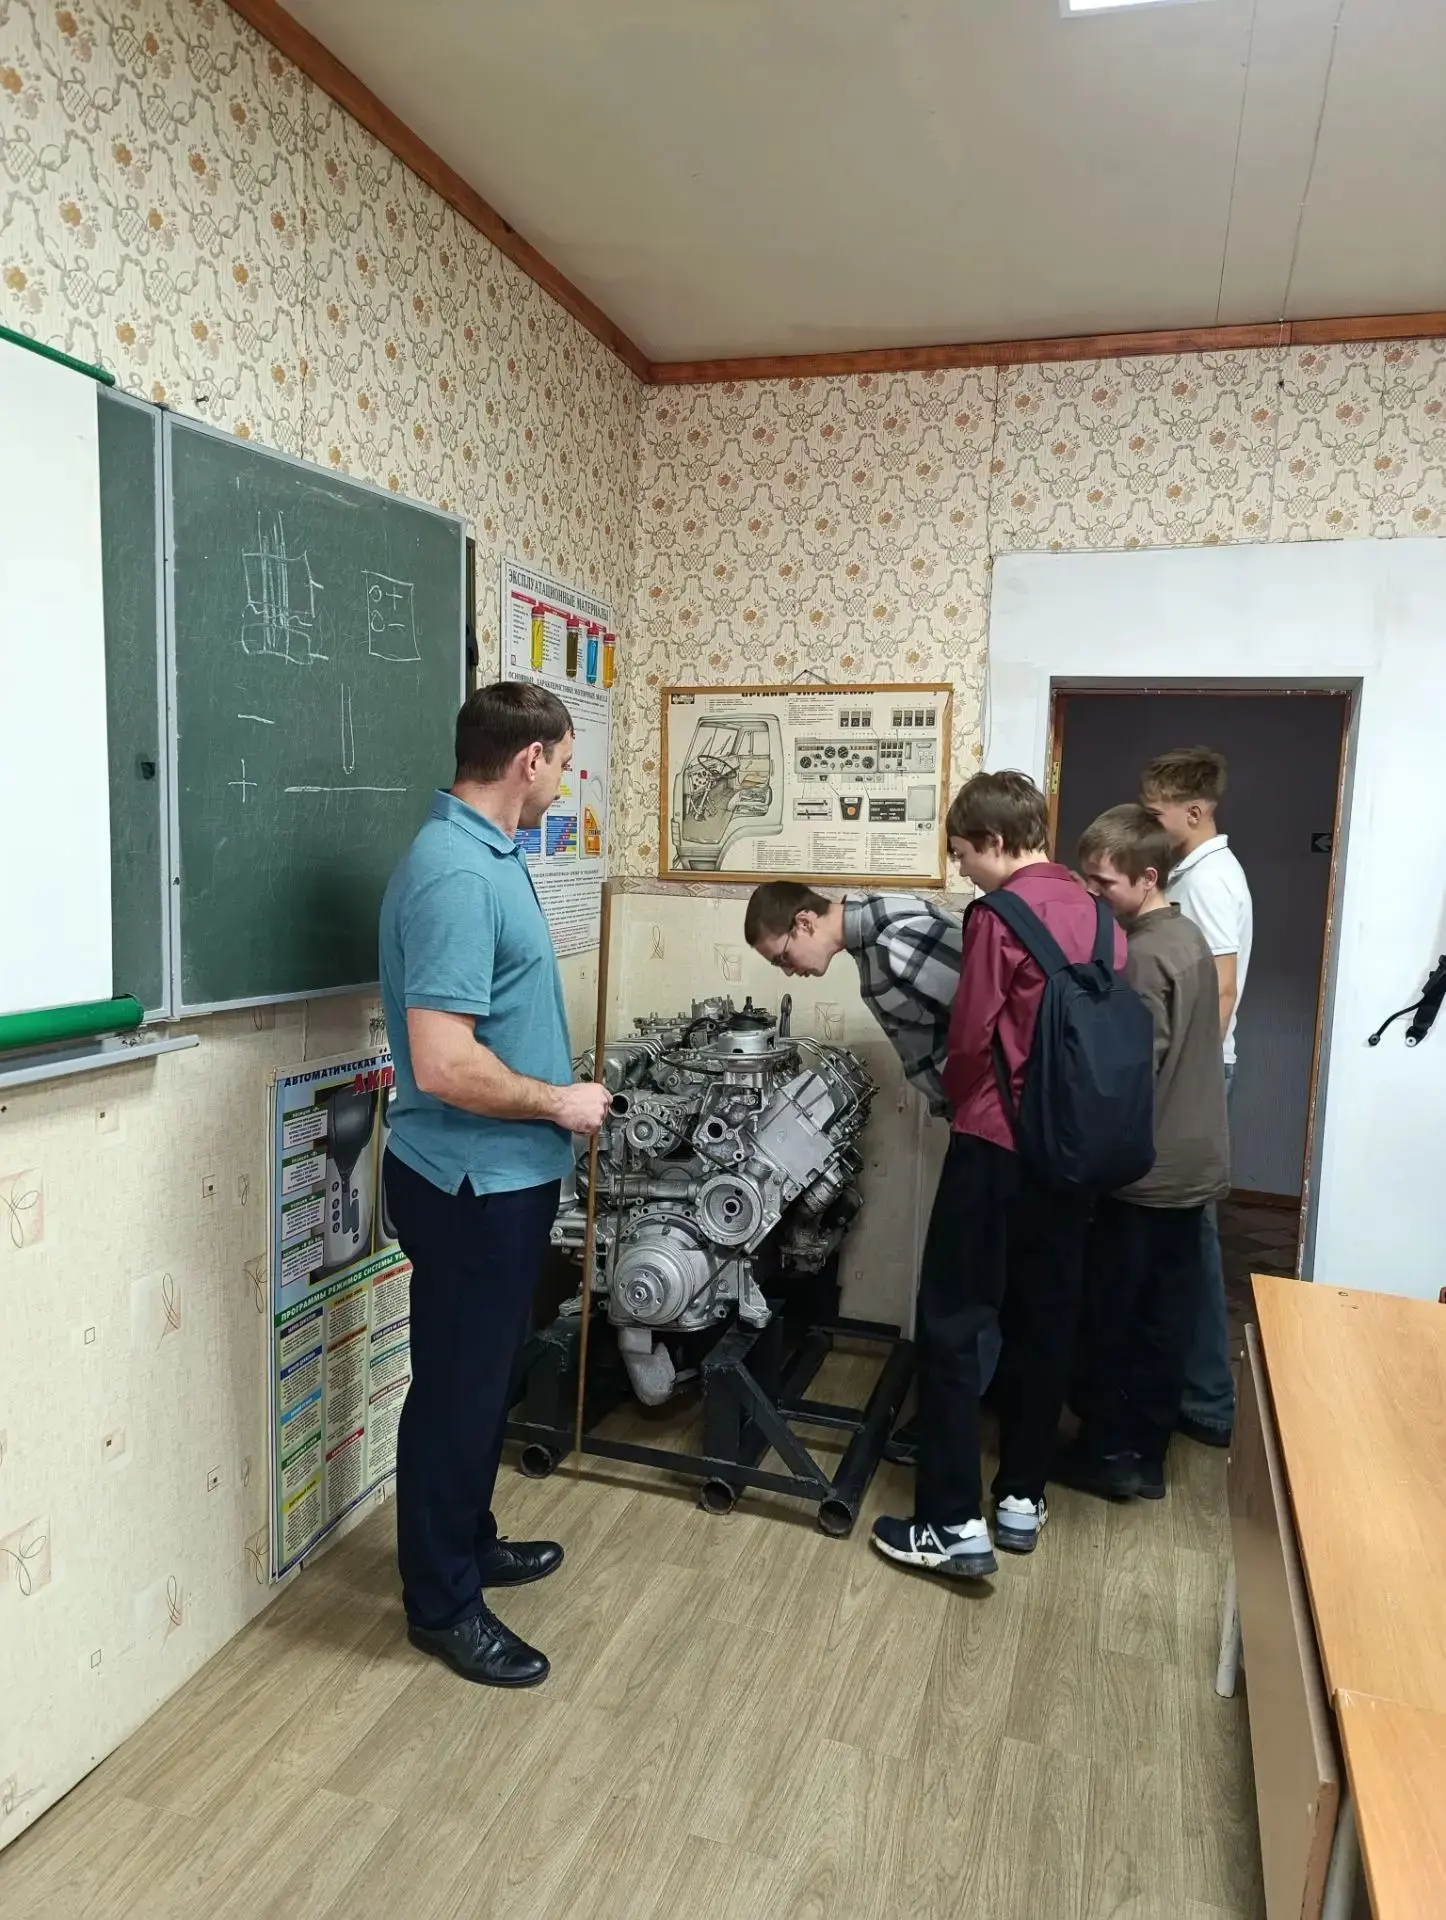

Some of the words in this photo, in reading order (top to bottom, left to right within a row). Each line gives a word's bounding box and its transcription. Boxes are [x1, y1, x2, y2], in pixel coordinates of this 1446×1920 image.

[508, 568, 575, 607] ЭКСПЛУАТАЦИОННЫЕ
[576, 594, 609, 622] МАТЕРИАЛЫ
[284, 1056, 377, 1088] АВТОМАТИЧЕСКАЯ
[281, 1290, 327, 1322] ПРОГРАММЫ
[328, 1271, 363, 1296] РЕЖИМОВ
[363, 1256, 393, 1277] СИСТЕМЫ
